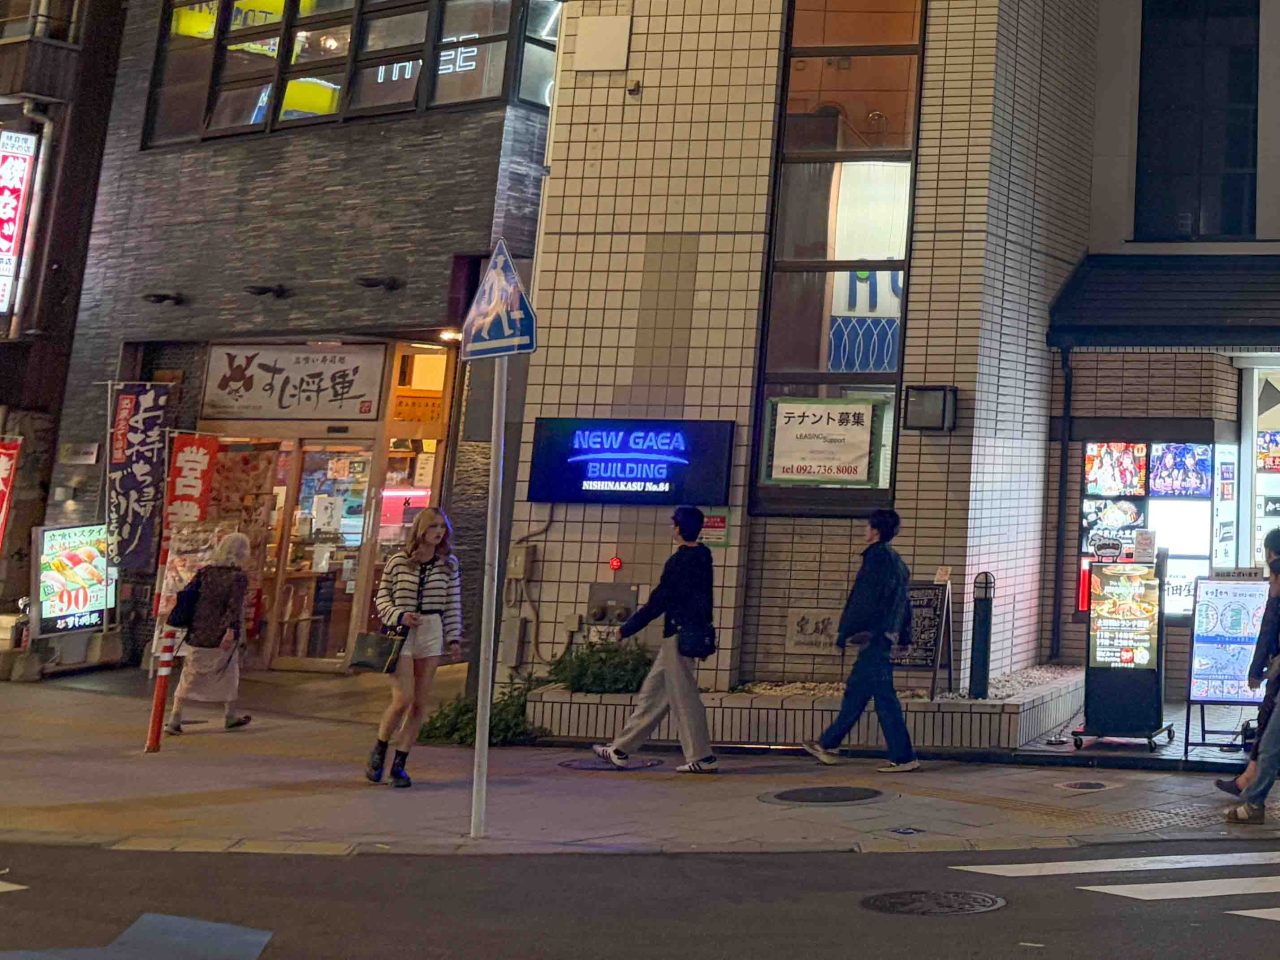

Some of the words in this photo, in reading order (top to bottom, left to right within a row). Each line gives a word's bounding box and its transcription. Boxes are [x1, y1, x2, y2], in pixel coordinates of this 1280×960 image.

[783, 411, 865, 427] テナント募集
[574, 431, 624, 449] NEW
[587, 462, 667, 478] BUILDING
[782, 465, 794, 474] tel
[796, 465, 858, 475] 092.736.8008
[582, 481, 644, 491] NISHINAKASU
